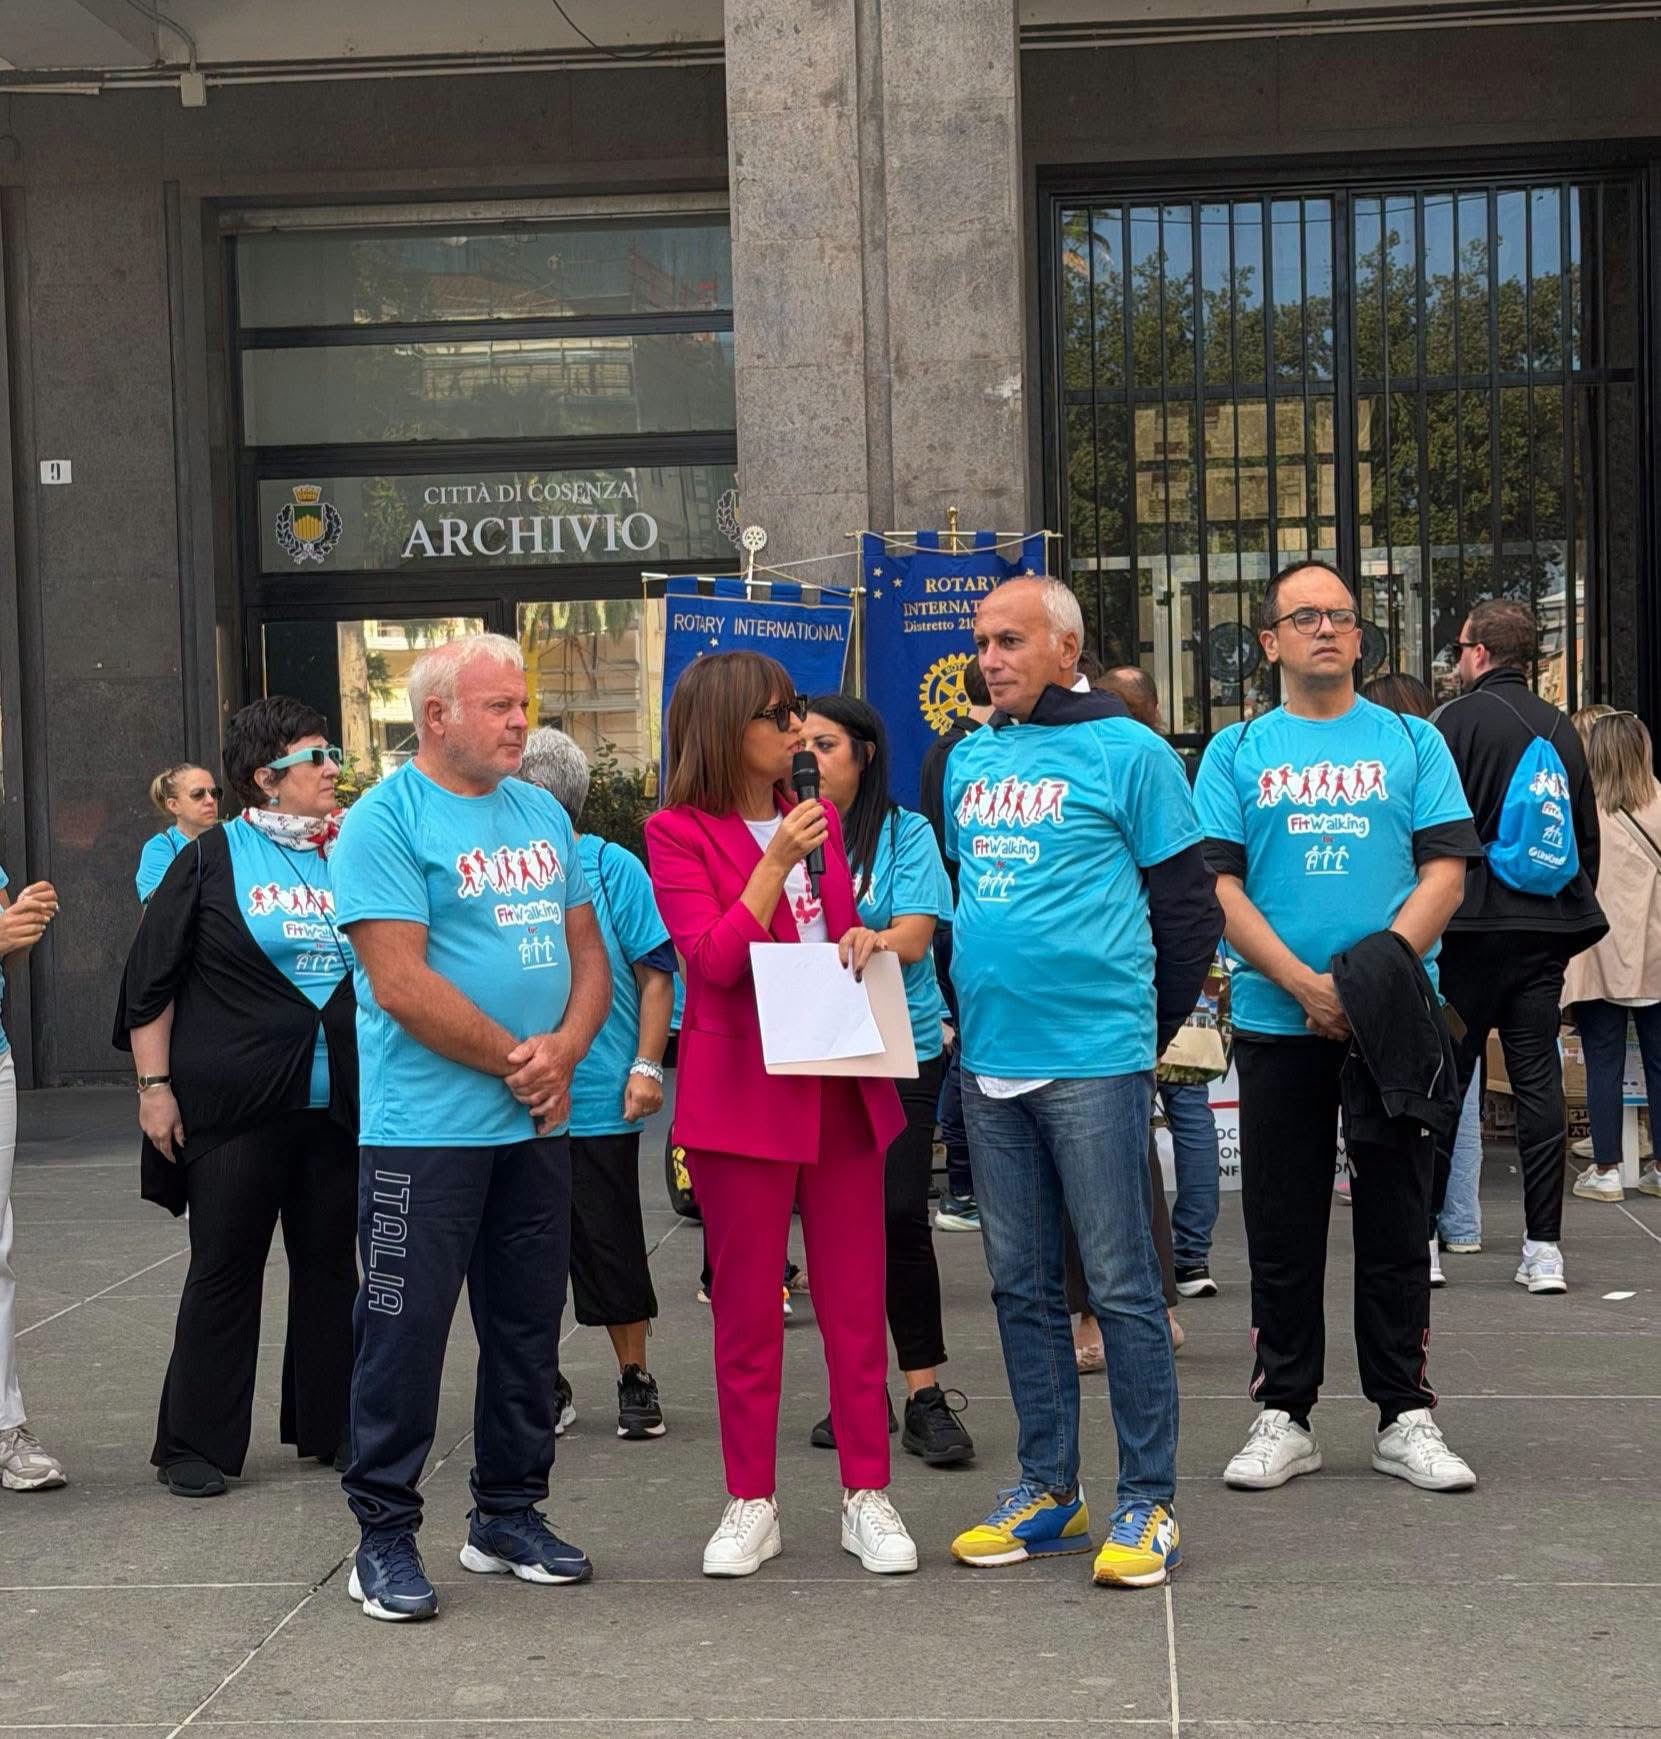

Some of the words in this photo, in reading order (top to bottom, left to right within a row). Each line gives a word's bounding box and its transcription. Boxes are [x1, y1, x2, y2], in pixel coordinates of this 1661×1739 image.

[424, 482, 492, 505] CITTÀ
[497, 484, 522, 502] DI
[528, 481, 636, 502] COSENZA
[401, 512, 658, 559] ARCHIVIO
[925, 575, 1001, 593] ROTARY
[904, 599, 983, 617] INTERNAT
[673, 613, 726, 634] ROTARY
[734, 617, 844, 642] INTERNATIONAL
[904, 620, 955, 633] Distretto
[368, 1170, 411, 1316] ITALIA
